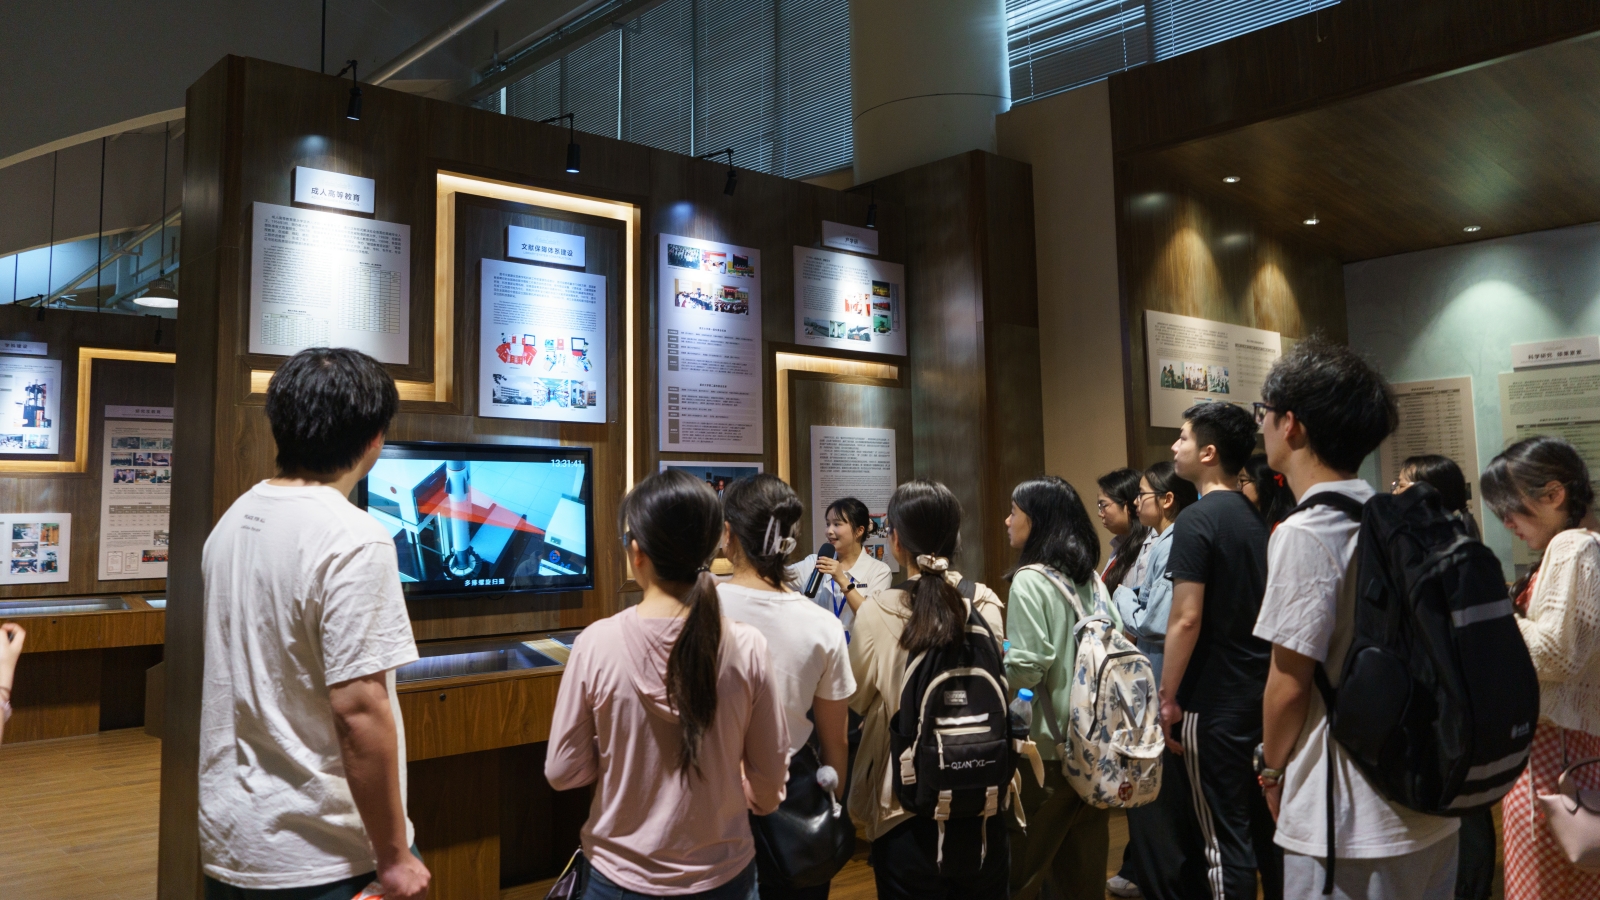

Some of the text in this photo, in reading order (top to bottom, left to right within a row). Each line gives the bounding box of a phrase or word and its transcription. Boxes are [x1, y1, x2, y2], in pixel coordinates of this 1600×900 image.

[311, 187, 360, 202] 成人高等教育
[521, 243, 573, 257] 文献保障体系建设
[1528, 352, 1553, 360] 科学研究
